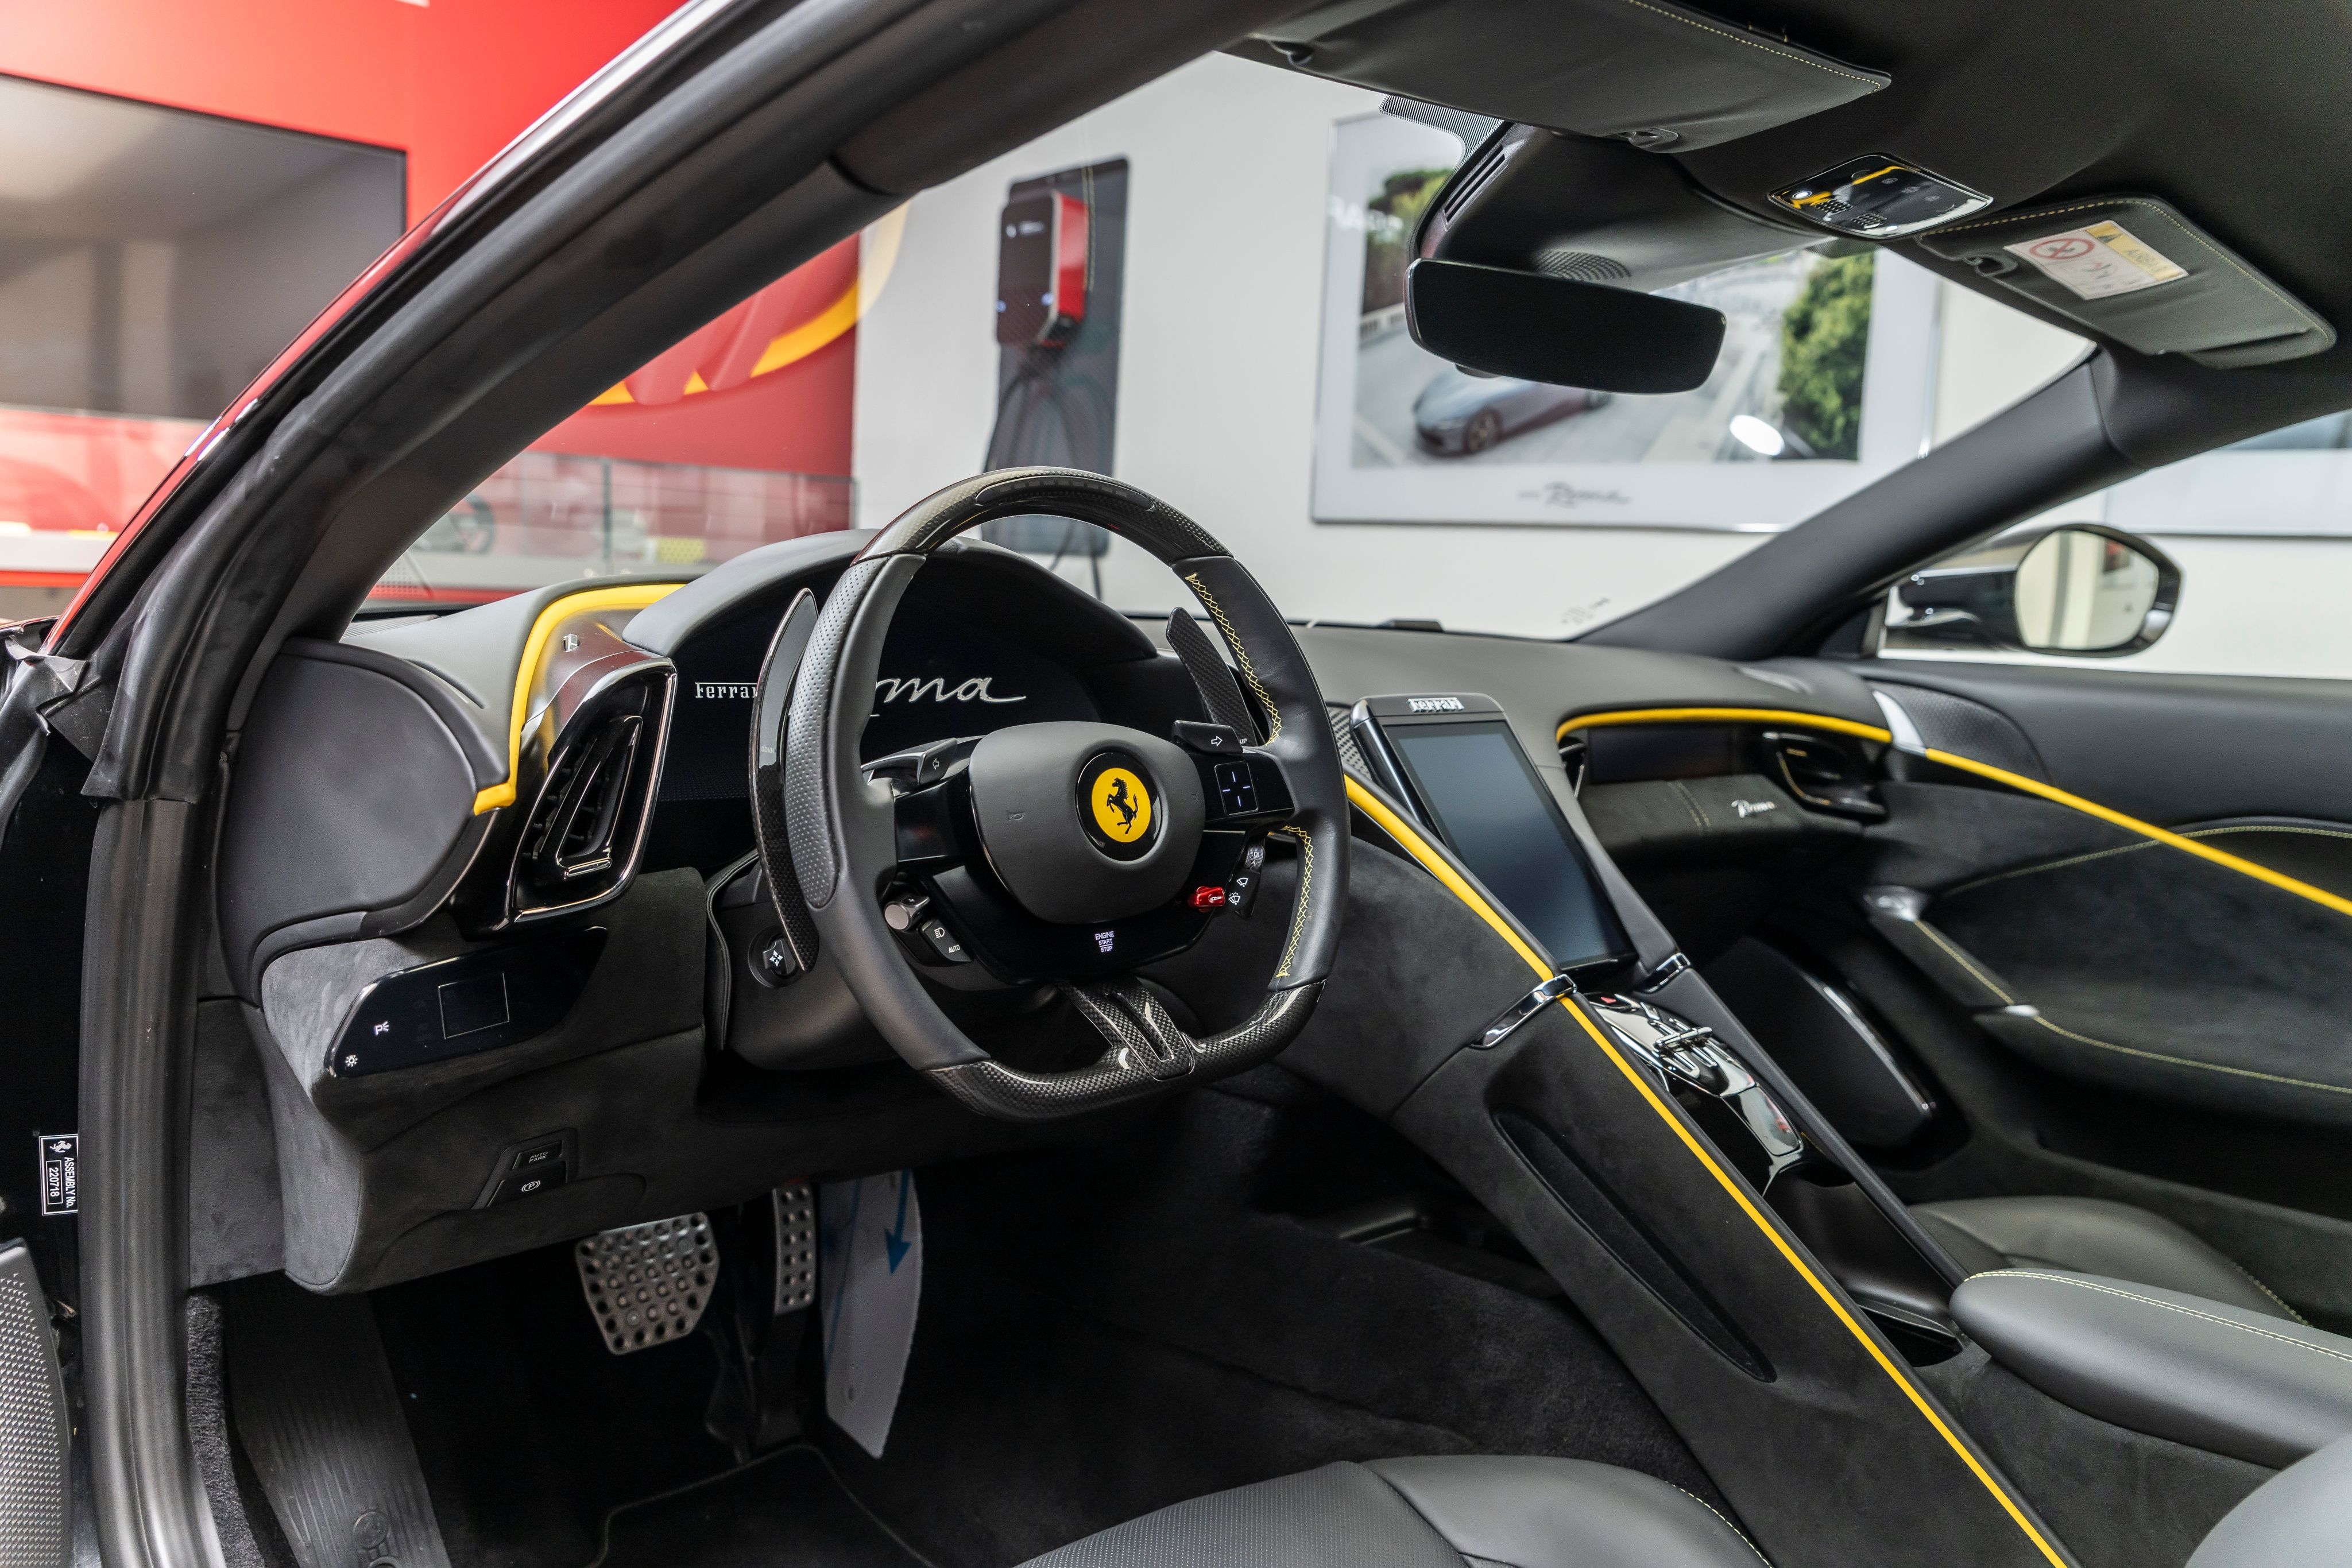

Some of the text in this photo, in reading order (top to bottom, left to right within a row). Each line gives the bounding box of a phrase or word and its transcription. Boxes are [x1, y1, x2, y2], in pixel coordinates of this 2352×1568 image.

[761, 745, 776, 754] DOWN
[1094, 931, 1115, 940] ENGINE
[949, 944, 961, 954] AUTO
[529, 1151, 548, 1159] AUTO
[529, 1155, 546, 1163] PARK
[49, 1167, 60, 1197] 220718
[64, 1156, 76, 1208] ASSEMBLY No.
